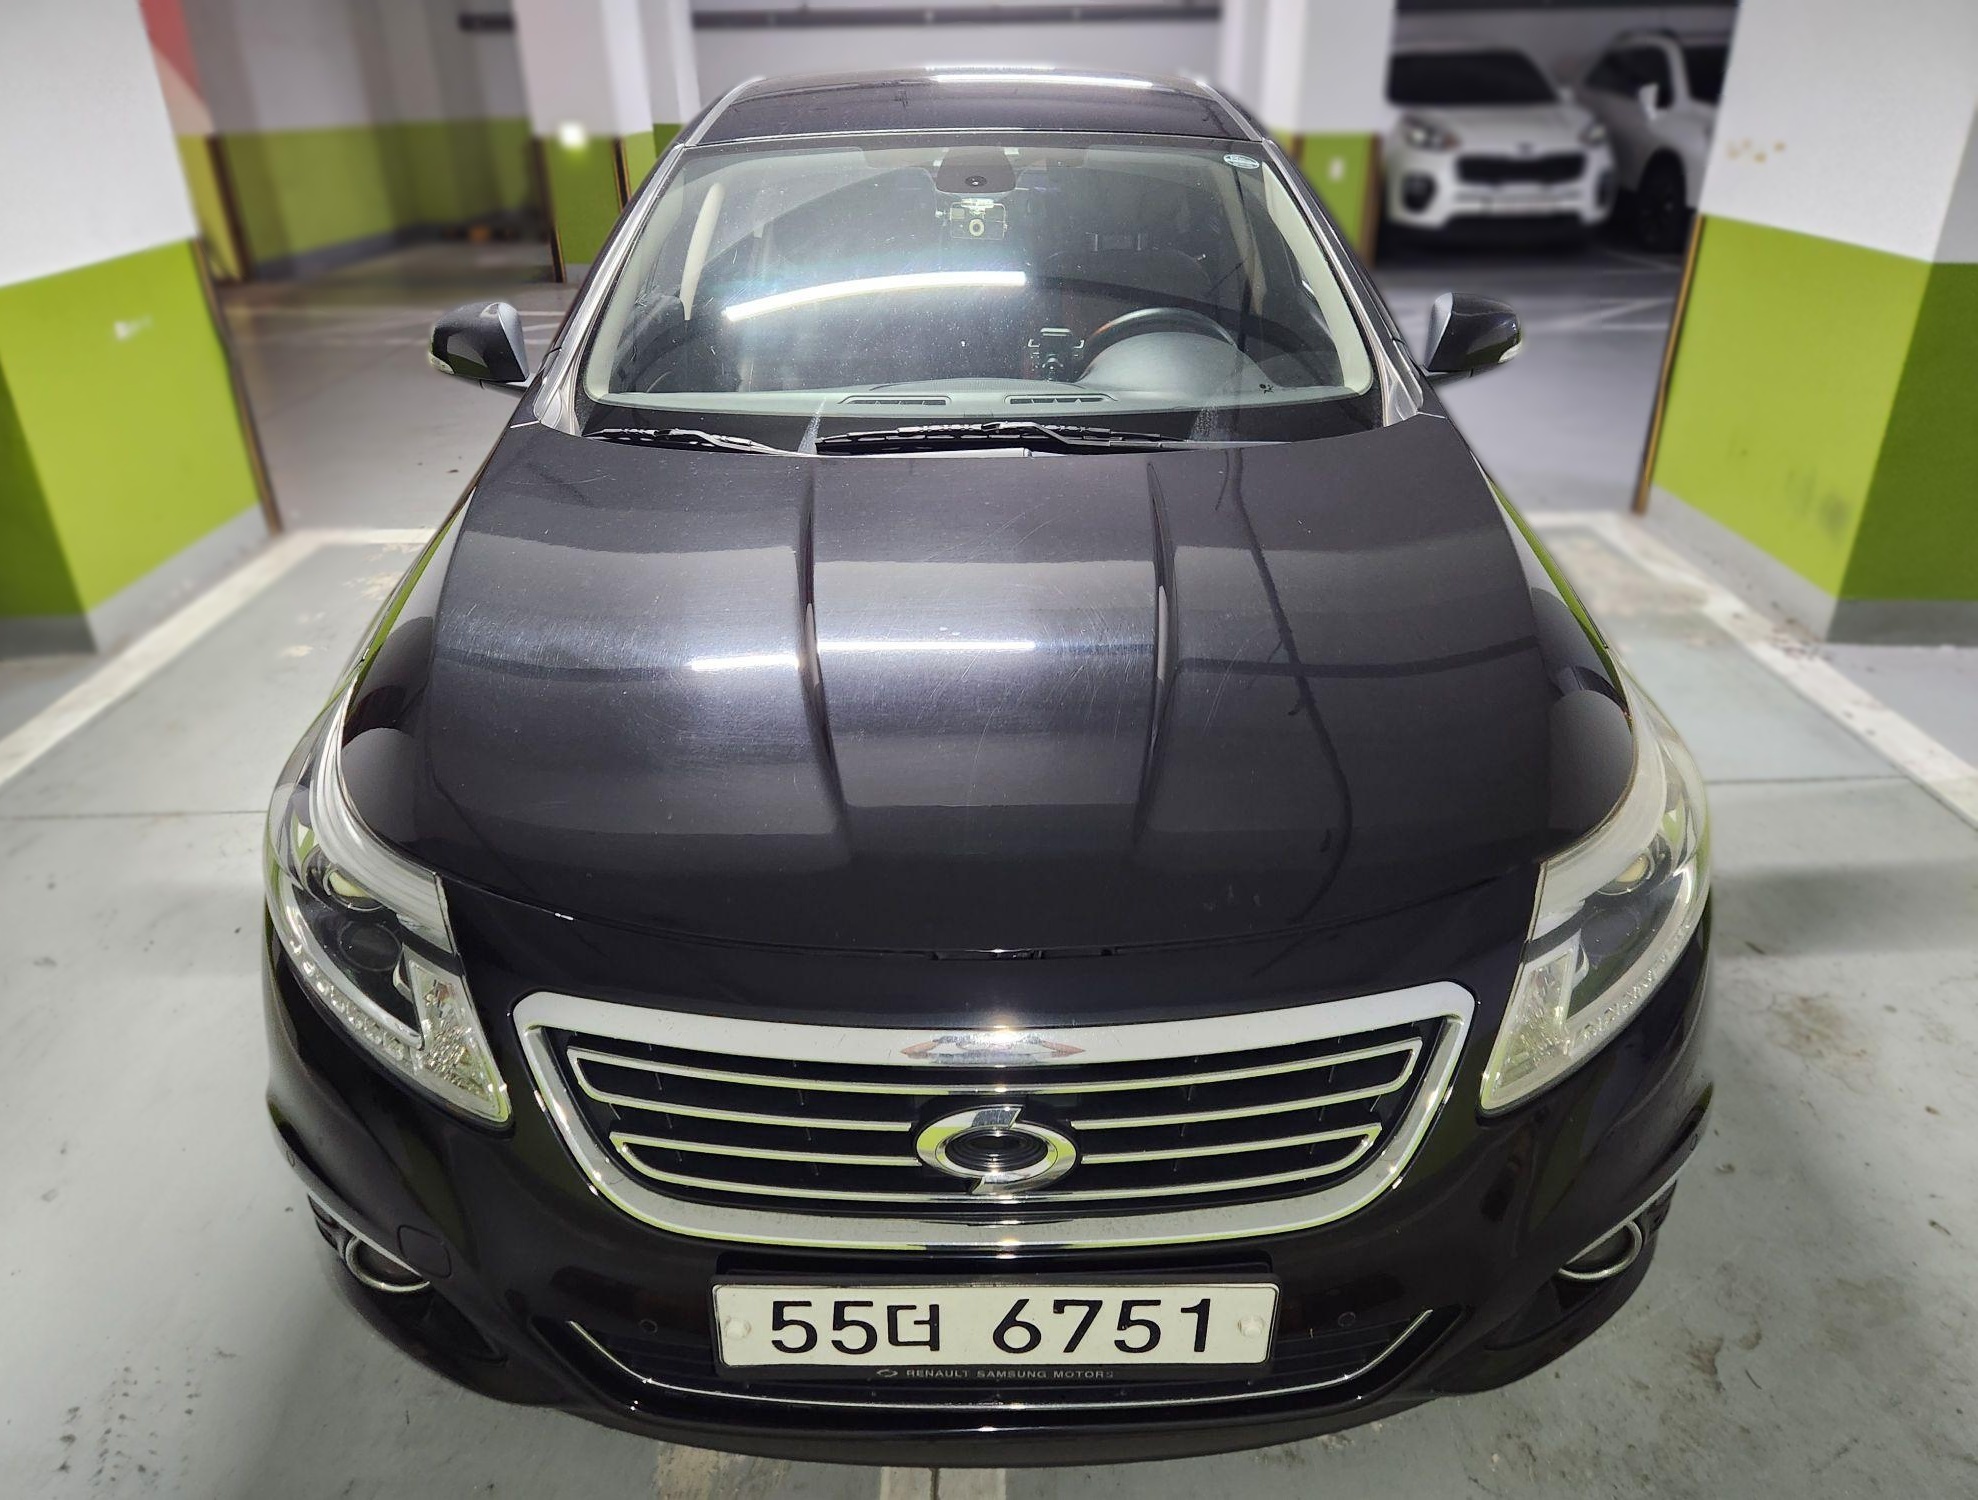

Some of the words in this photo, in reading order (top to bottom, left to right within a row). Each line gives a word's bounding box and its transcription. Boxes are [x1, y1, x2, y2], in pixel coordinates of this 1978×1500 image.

[771, 1300, 940, 1355] 55더
[992, 1298, 1211, 1354] 6751
[905, 1369, 969, 1379] RENAULT
[976, 1369, 1047, 1379] SAMSUNG
